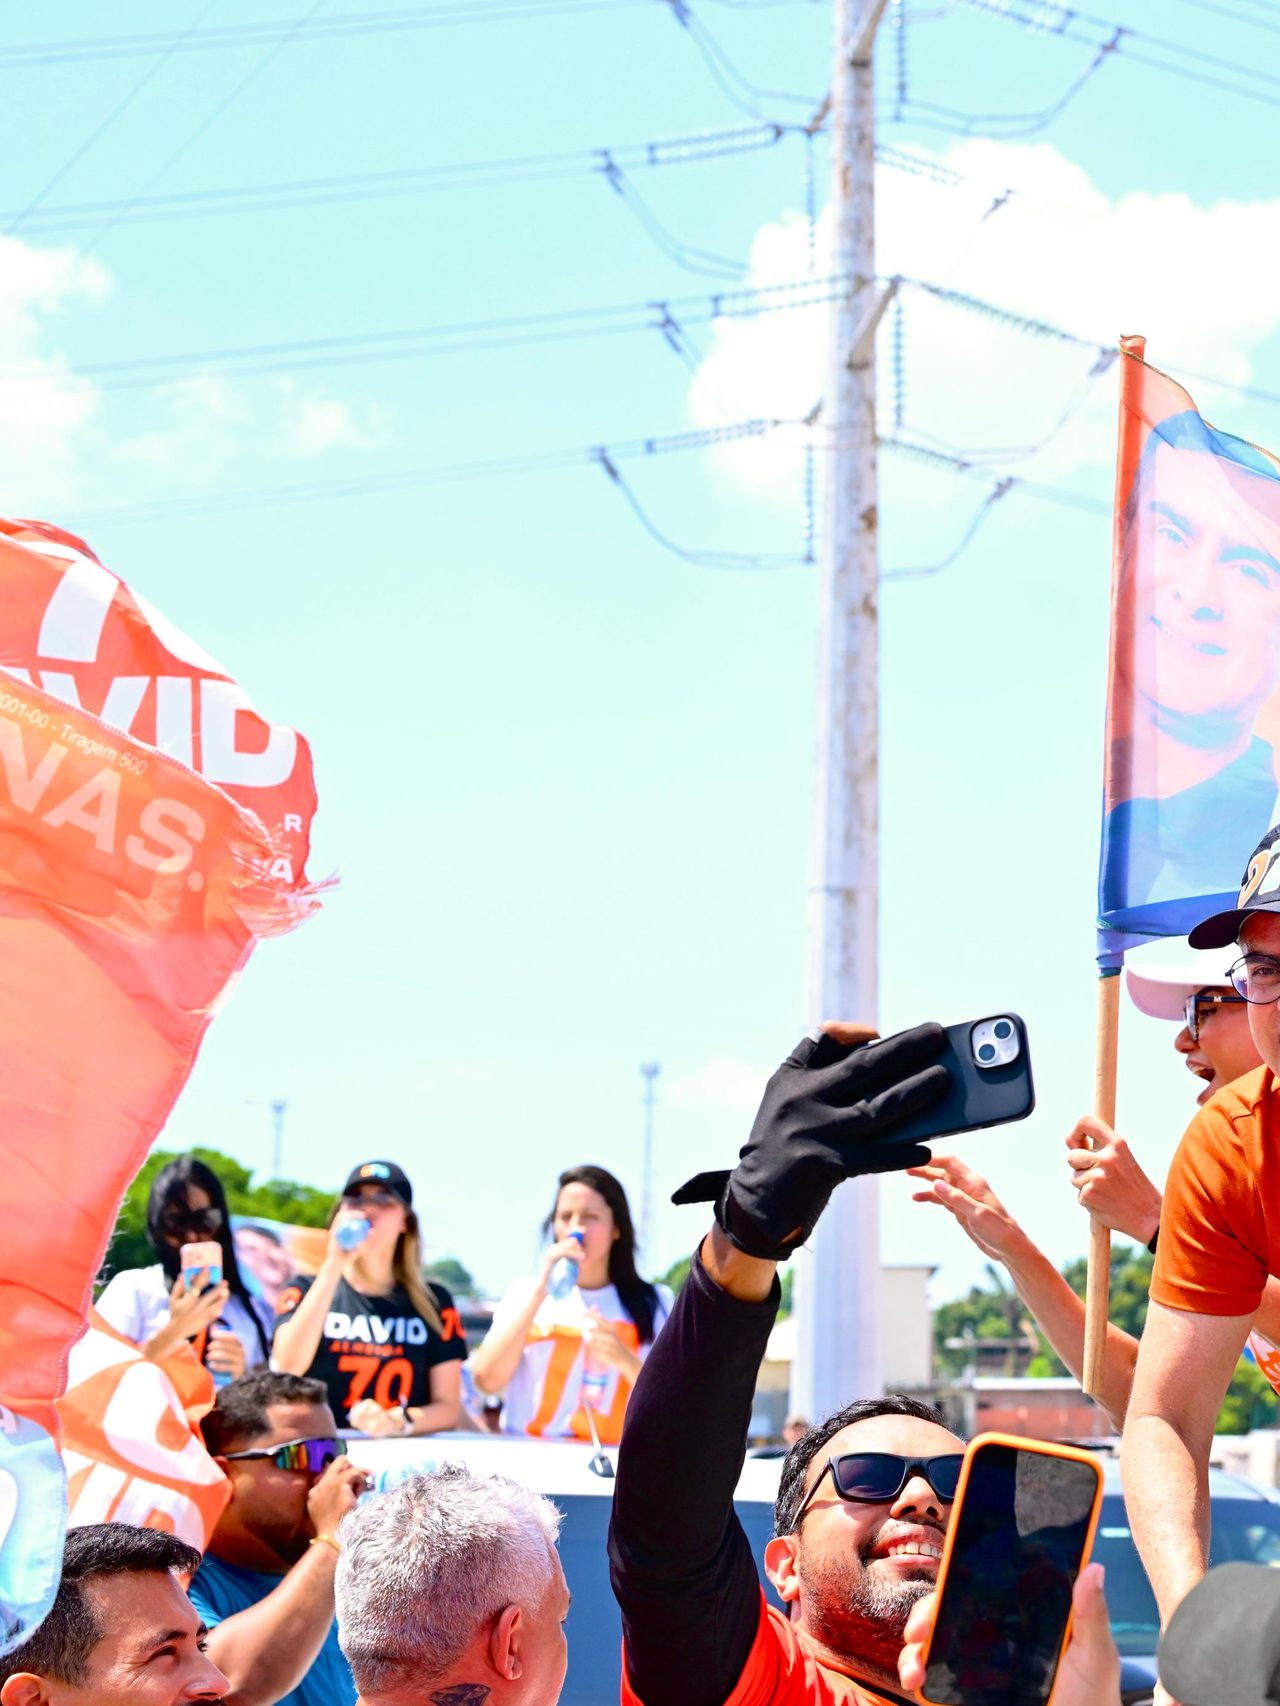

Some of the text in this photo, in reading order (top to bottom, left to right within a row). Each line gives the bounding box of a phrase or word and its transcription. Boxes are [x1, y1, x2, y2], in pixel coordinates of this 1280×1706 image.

[62, 723, 118, 760] Tiragem
[118, 752, 147, 775] 500
[324, 1312, 427, 1345] DAVID
[337, 1354, 414, 1410] 70
